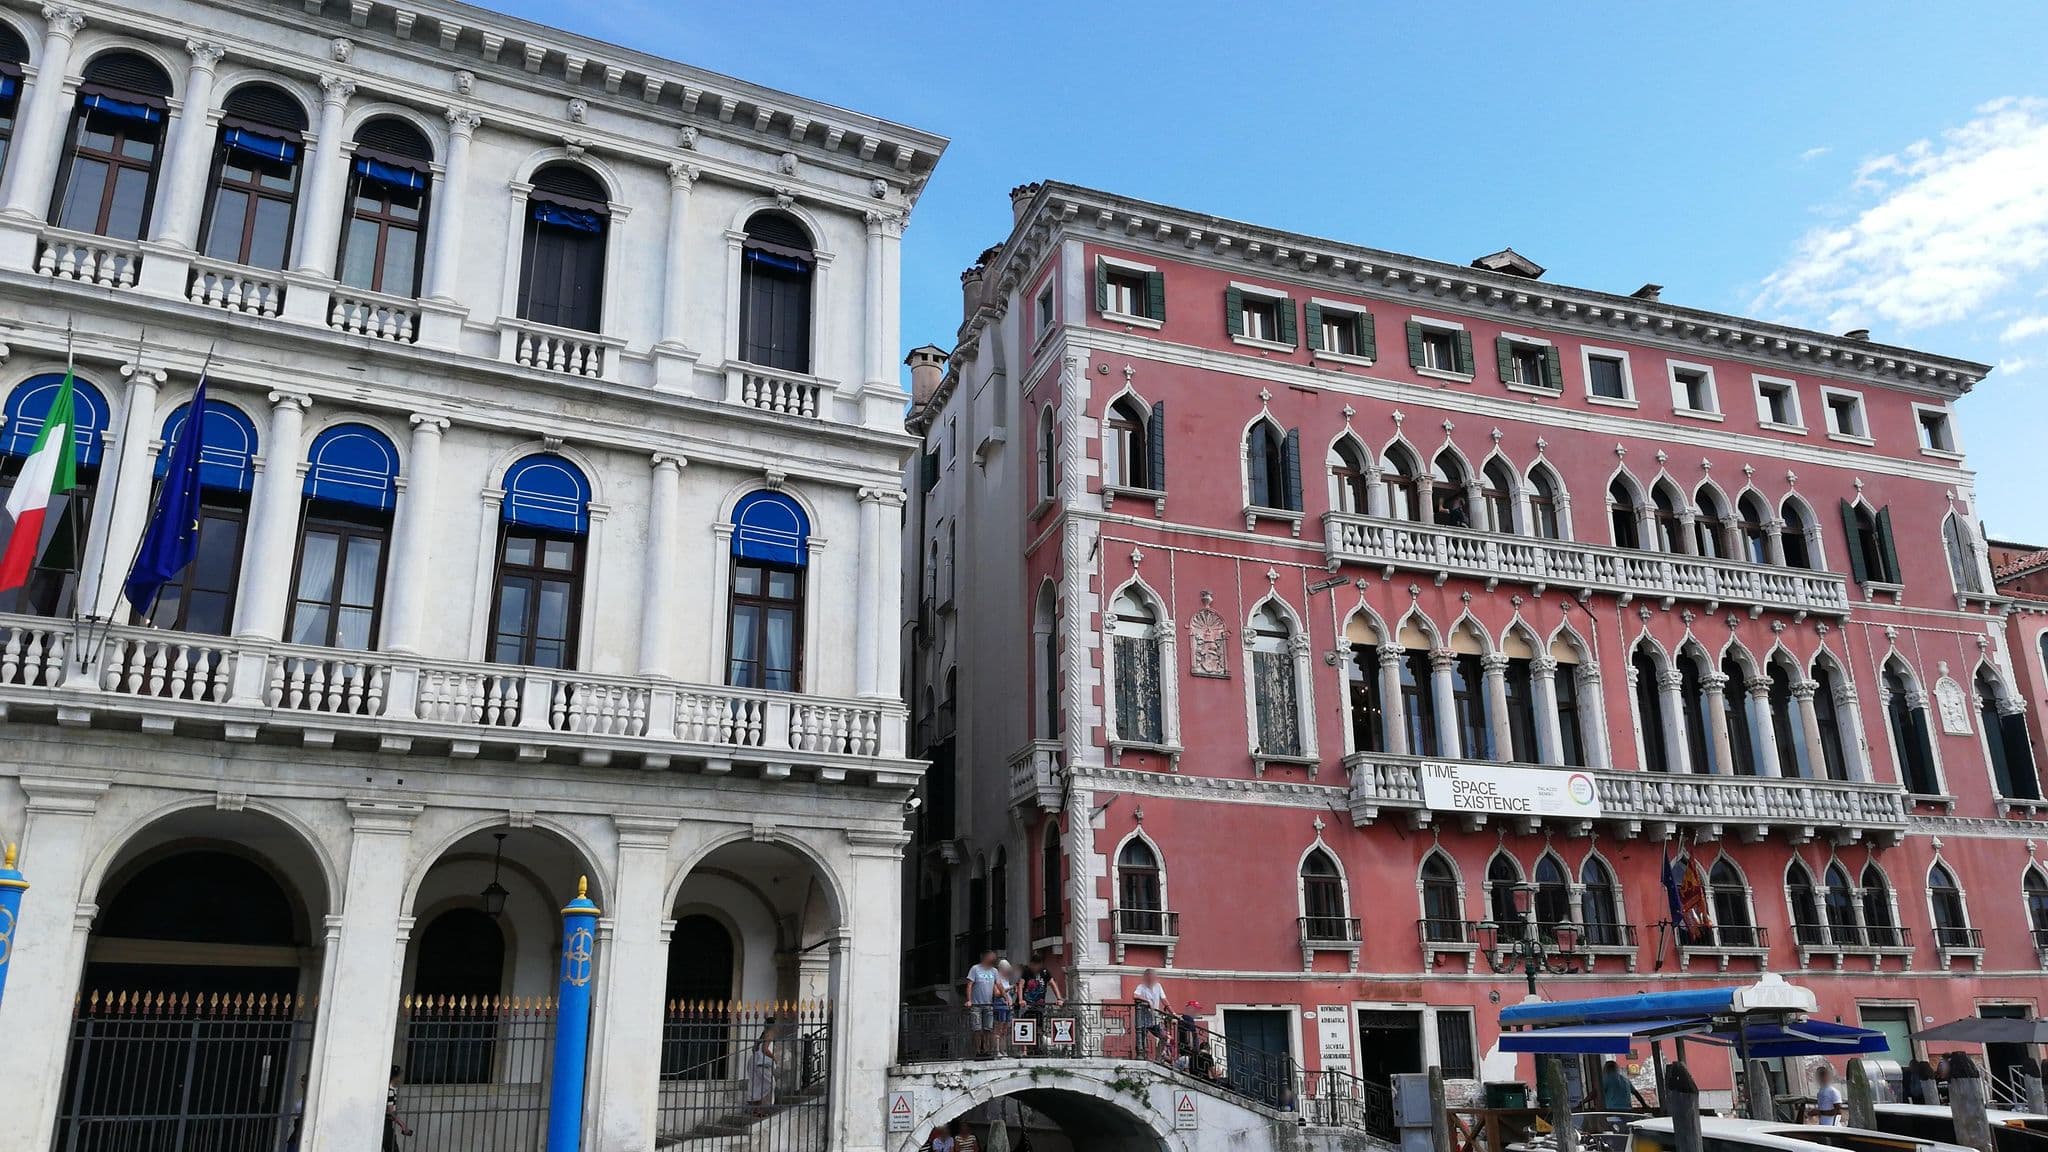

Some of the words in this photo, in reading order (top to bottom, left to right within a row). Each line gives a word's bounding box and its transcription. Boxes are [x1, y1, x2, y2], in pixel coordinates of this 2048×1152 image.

[1424, 764, 1459, 779] TIME
[1452, 780, 1497, 795] SPACE
[1454, 795, 1531, 811] EXISTENCE
[1020, 1025, 1028, 1036] 5
